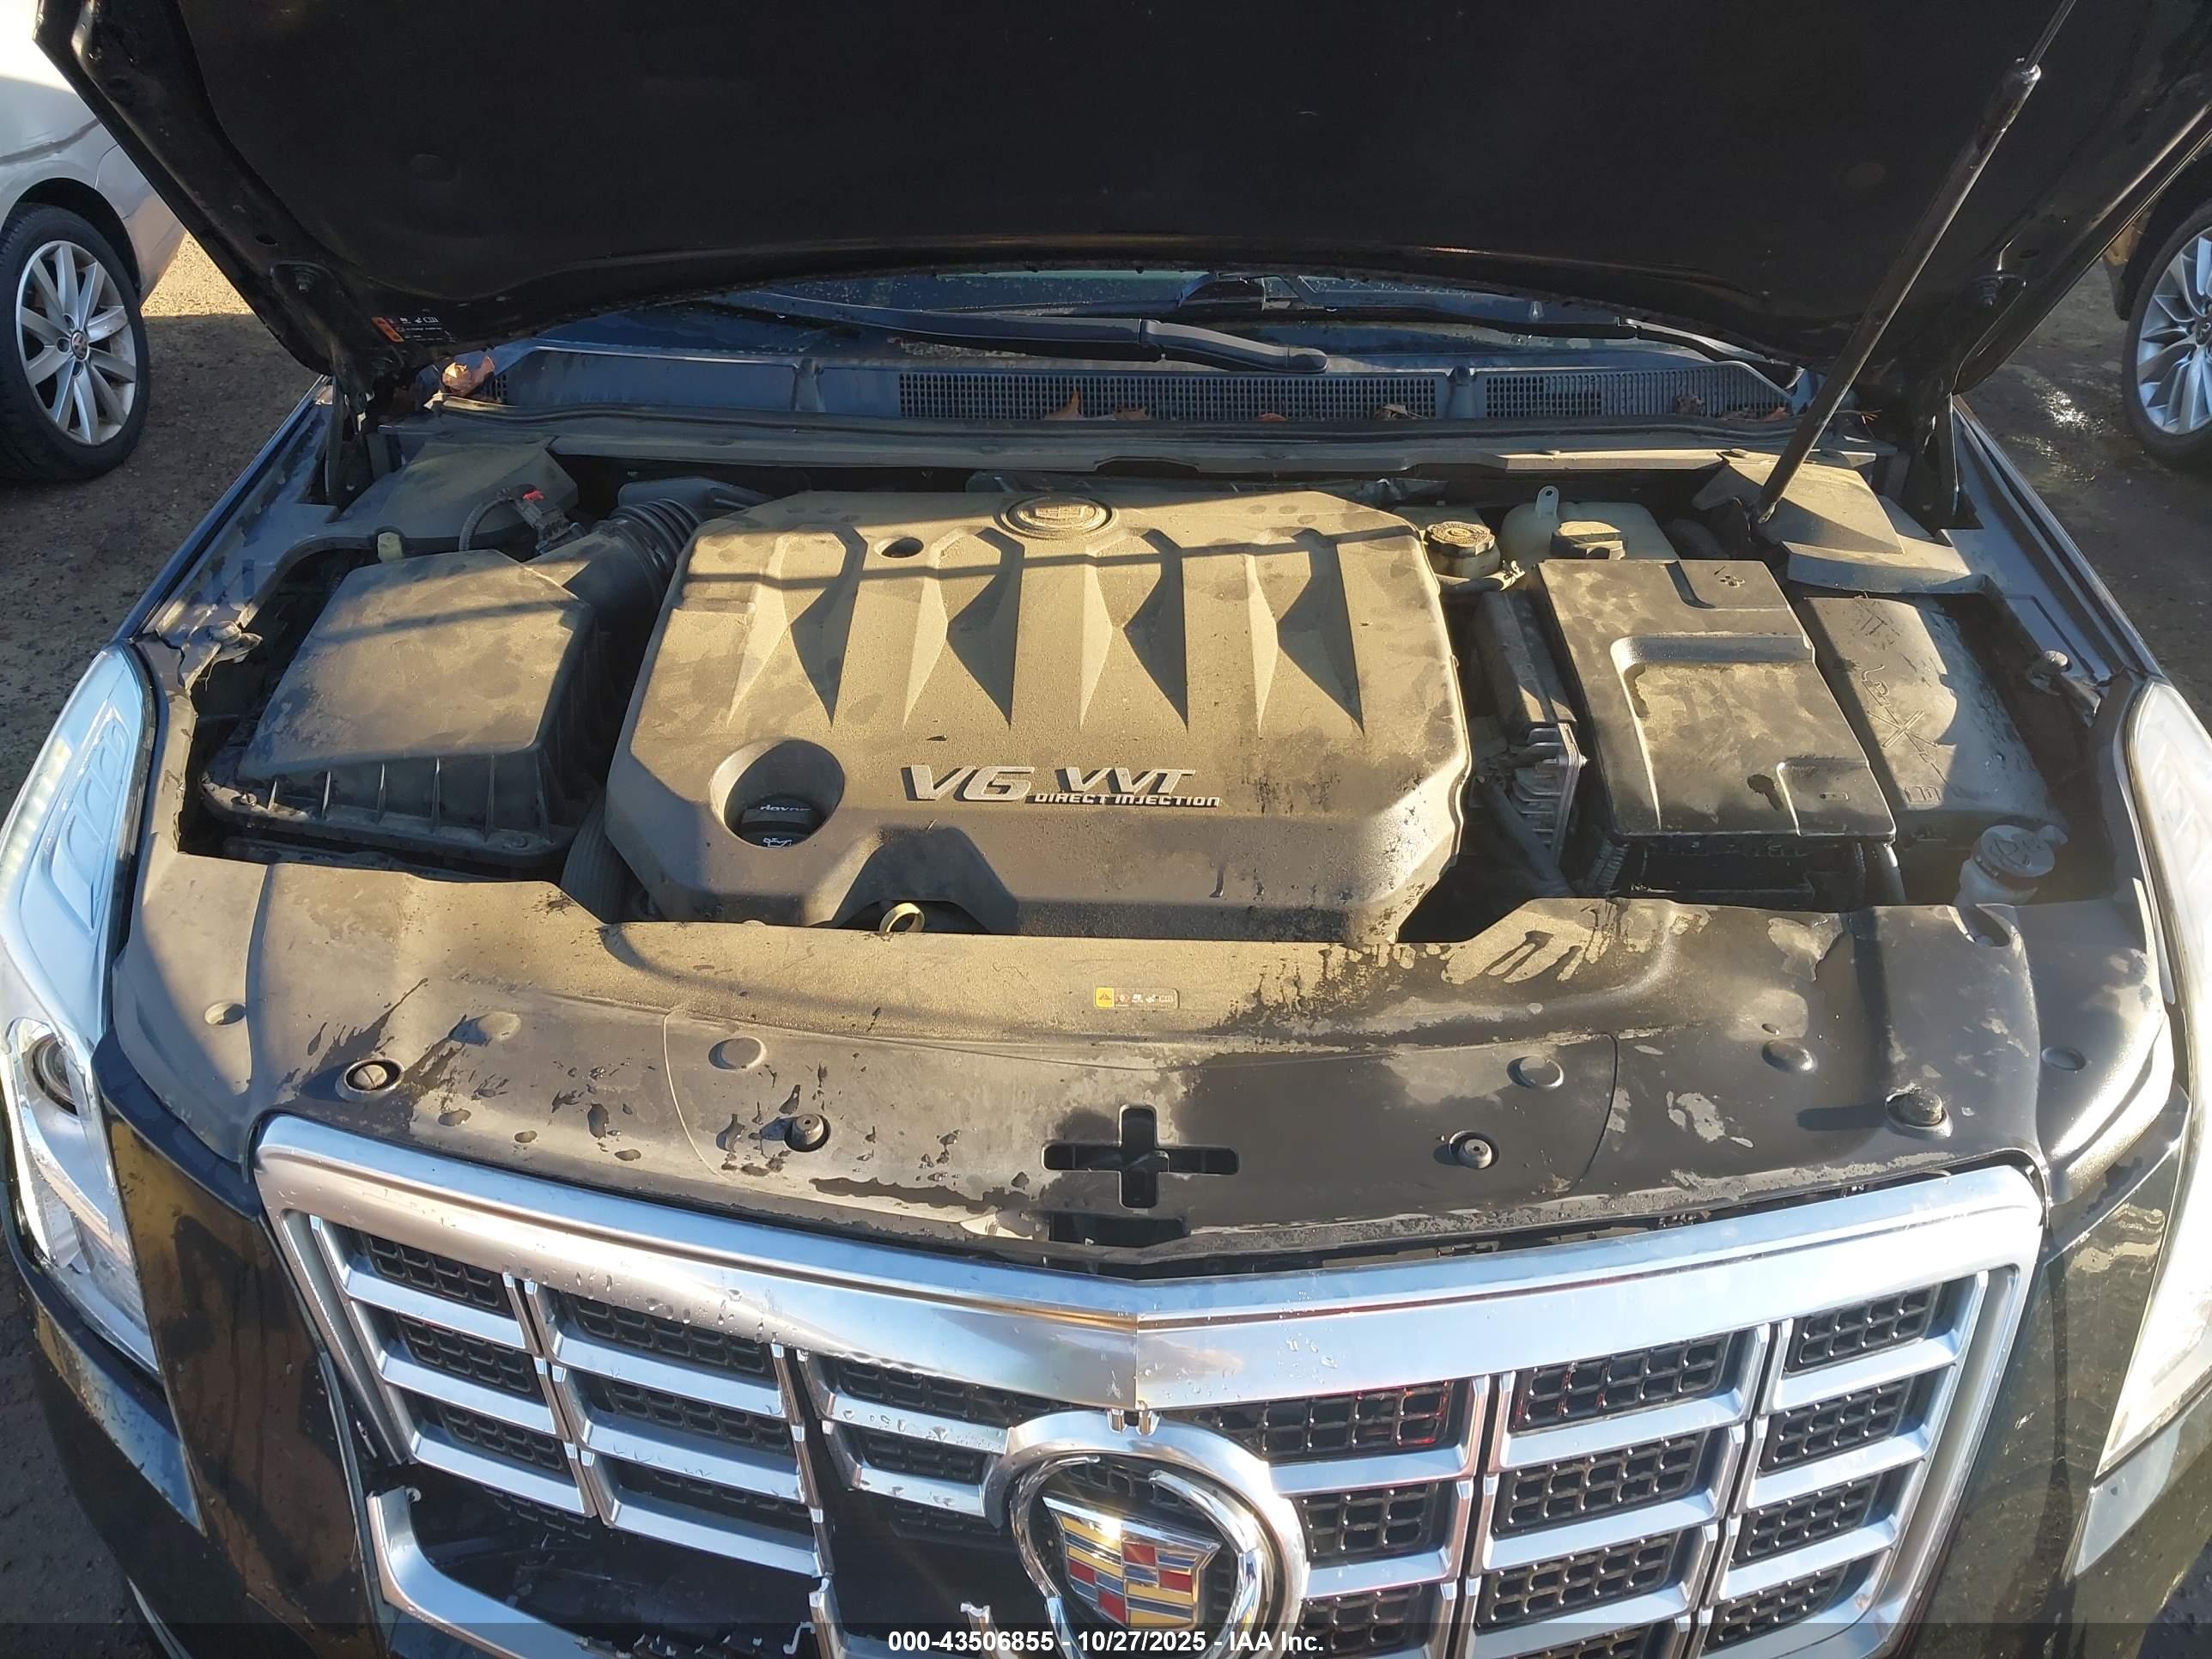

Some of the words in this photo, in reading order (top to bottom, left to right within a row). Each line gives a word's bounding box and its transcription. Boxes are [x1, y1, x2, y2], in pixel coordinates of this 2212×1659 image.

[910, 764, 1036, 800] V6
[1065, 766, 1196, 795] VVT
[1034, 793, 1109, 805] DIRECT
